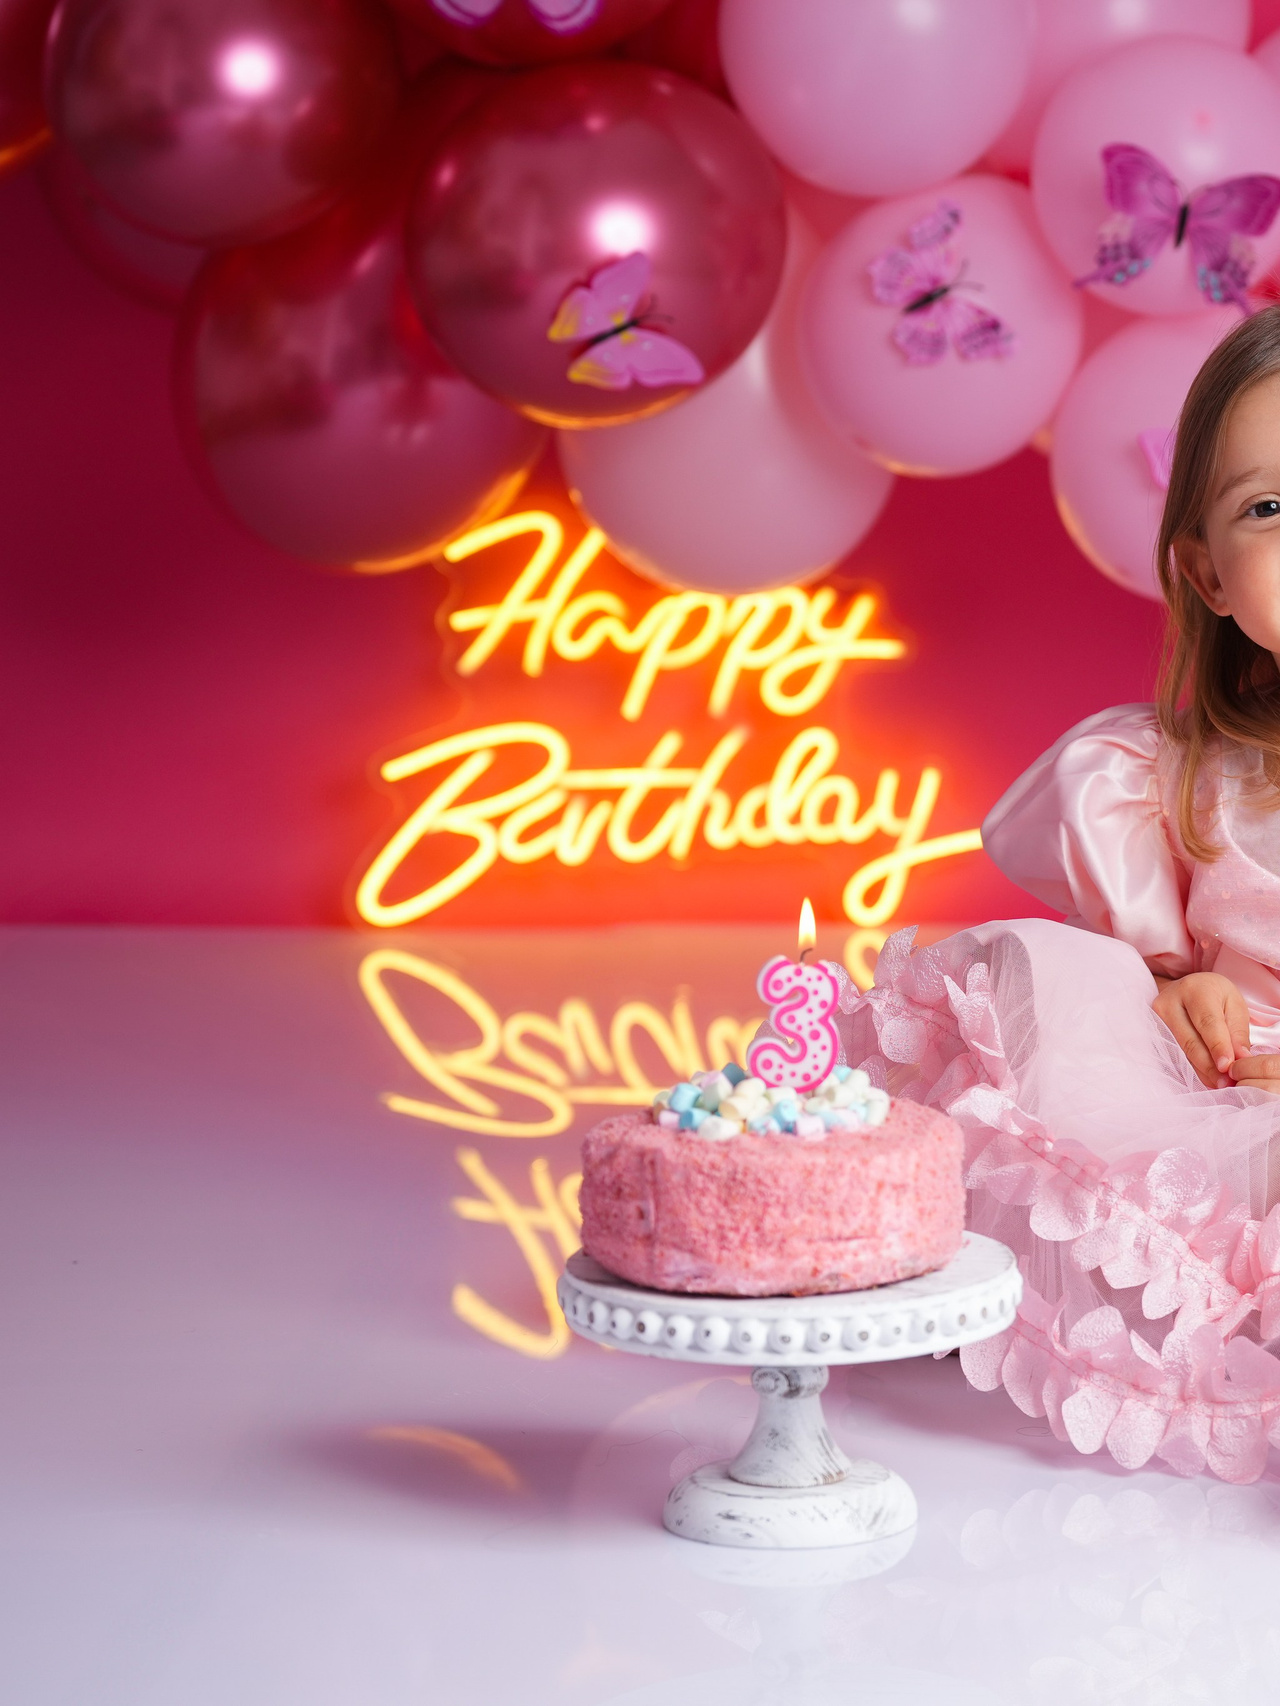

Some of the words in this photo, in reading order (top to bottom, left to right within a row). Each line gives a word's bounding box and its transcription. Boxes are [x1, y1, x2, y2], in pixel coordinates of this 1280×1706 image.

[443, 509, 906, 721] Happy
[355, 720, 984, 928] Birthday
[746, 954, 839, 1093] 3
